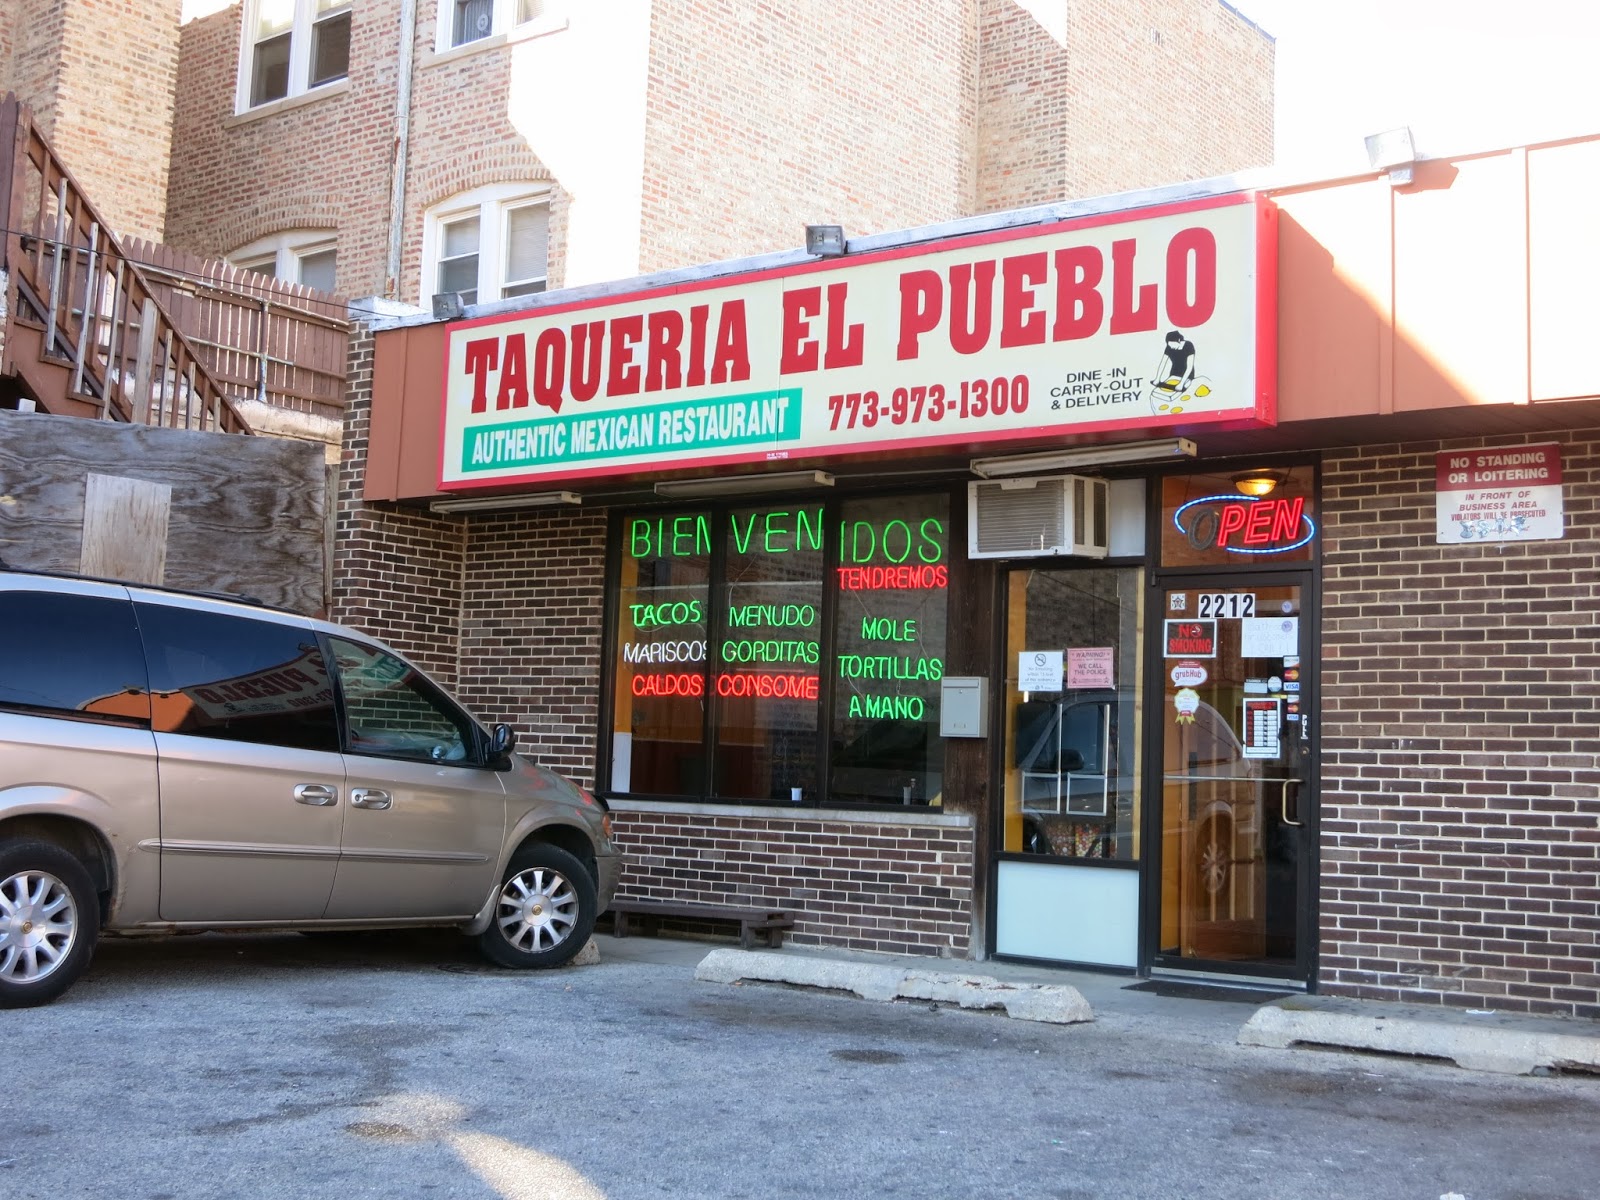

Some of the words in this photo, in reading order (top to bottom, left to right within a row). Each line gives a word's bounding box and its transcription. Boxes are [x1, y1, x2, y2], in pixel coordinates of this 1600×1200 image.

[465, 299, 750, 414] TAQUERIA
[780, 282, 865, 376] EL
[897, 226, 1217, 362] PUEBLO
[1050, 376, 1144, 398] CARRY-OUT
[1066, 369, 1103, 384] DINE
[828, 374, 1030, 431] 773-973-1300
[1051, 399, 1061, 410] &
[1064, 390, 1143, 409] DELIVERY
[472, 422, 566, 465] AUTHENTIC
[570, 413, 654, 455] MEXICAN
[659, 396, 789, 445] RESTAURANT
[1450, 457, 1470, 469] NO
[1476, 452, 1546, 467] STANDING
[1448, 473, 1468, 483] OR
[1474, 467, 1548, 482] LOITERING
[1459, 502, 1506, 512] BUSINESS
[1511, 501, 1537, 509] AREA
[1465, 493, 1474, 501] IN
[1480, 491, 1512, 500] FRONT
[1517, 490, 1531, 498] OF
[1187, 497, 1304, 550] OPEN
[1451, 512, 1481, 521] VIOLATORS
[631, 515, 712, 558] BIEN
[731, 508, 824, 554] VEN
[840, 518, 944, 563] IDOS
[837, 565, 948, 591] TENDREMOS
[629, 600, 702, 627] TACOS
[728, 604, 815, 628] MENUDO
[1200, 594, 1255, 618] 2212
[861, 616, 917, 642] MOLE
[721, 640, 820, 664] GORDITAS
[1169, 638, 1212, 654] SMOKING
[837, 655, 944, 681] TORTILLAS
[631, 673, 704, 696] CALDOS
[717, 674, 819, 700] CONSOME
